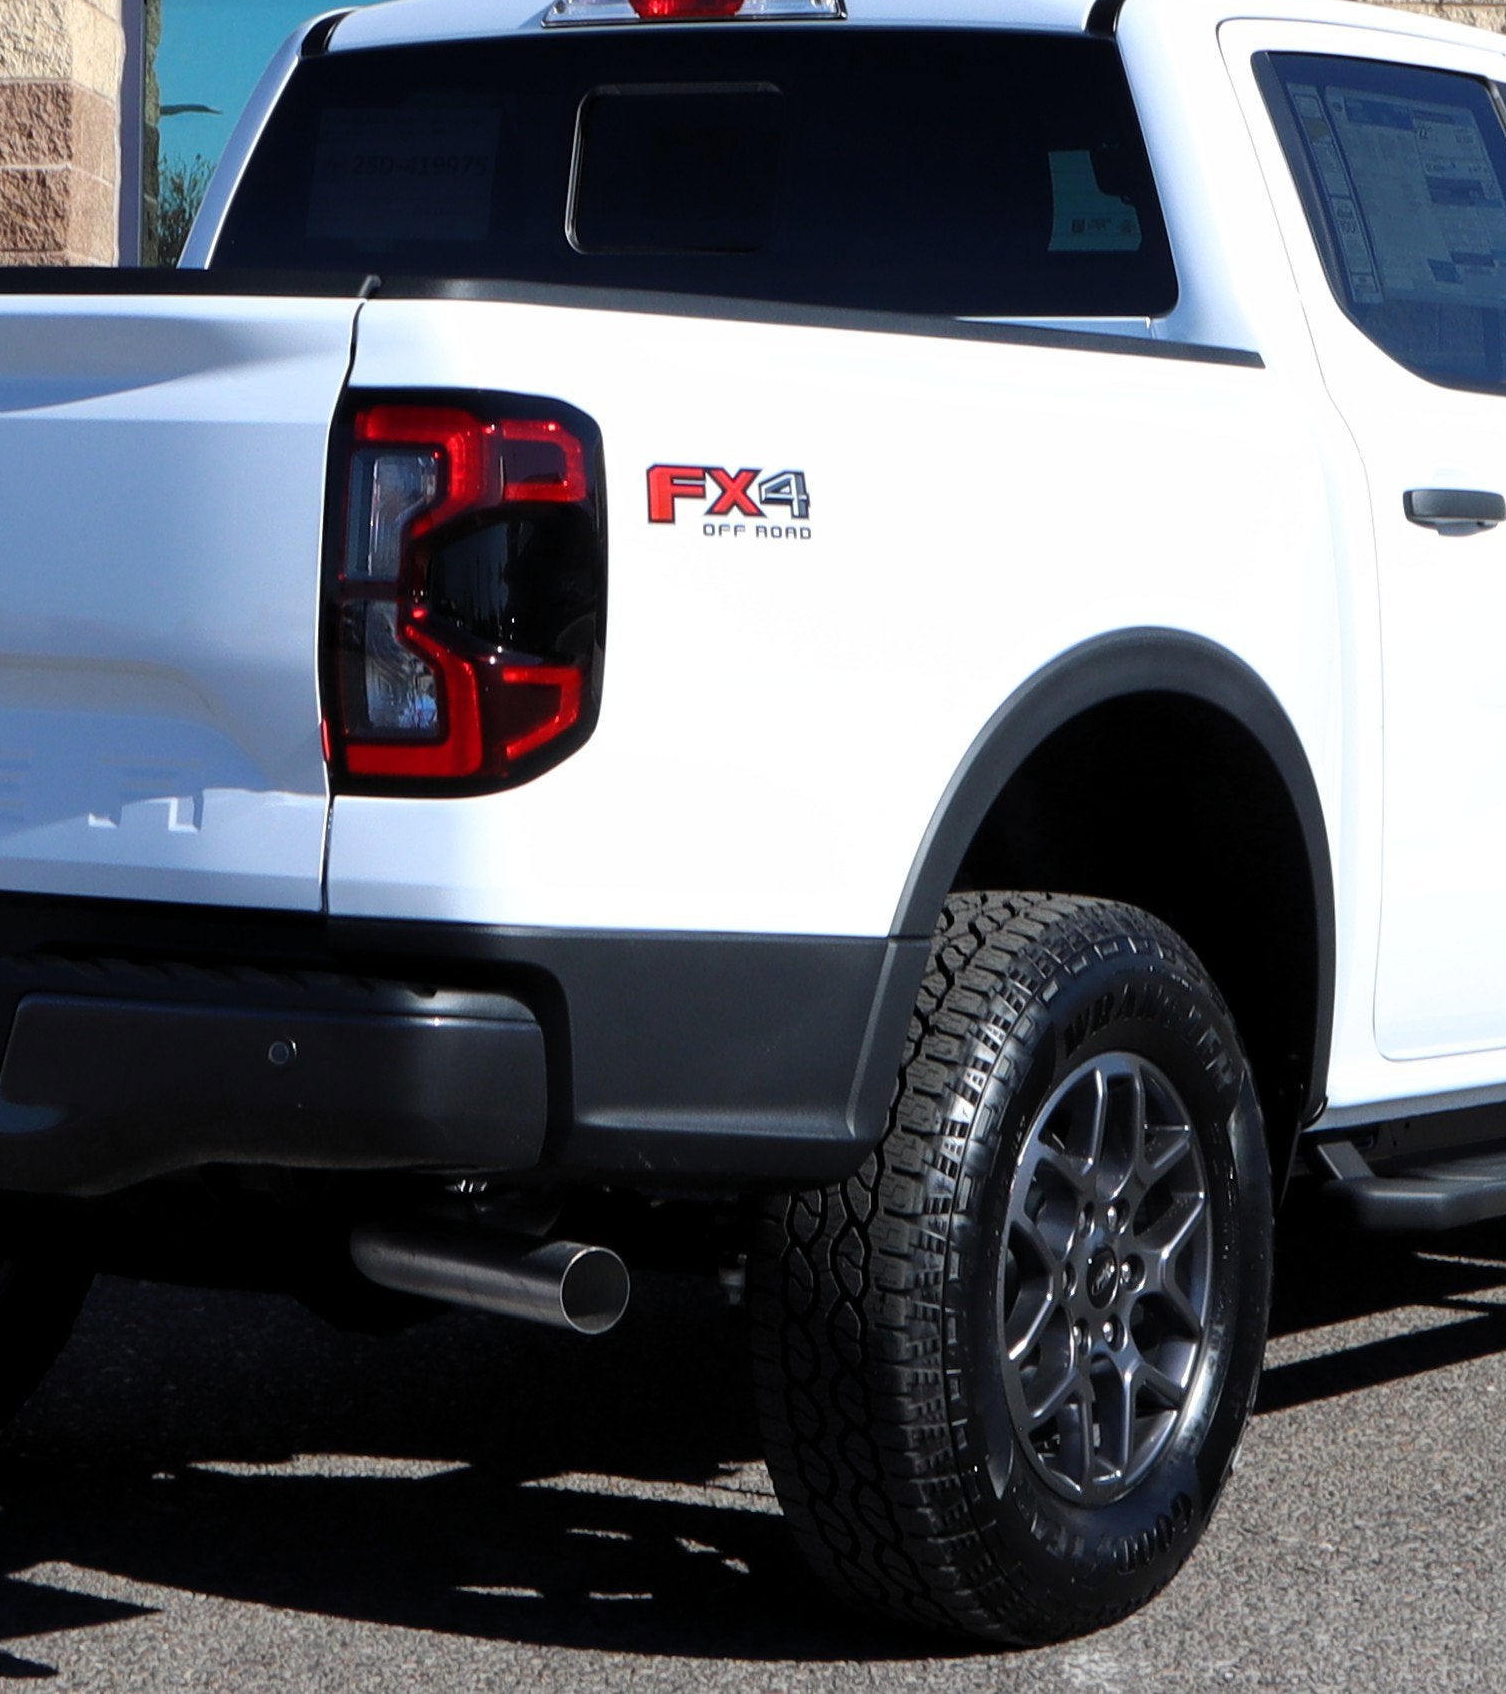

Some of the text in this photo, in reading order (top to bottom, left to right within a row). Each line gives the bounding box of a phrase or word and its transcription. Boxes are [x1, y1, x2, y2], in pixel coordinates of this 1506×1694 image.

[646, 463, 810, 524] FX4
[703, 523, 812, 540] OFF ROAD
